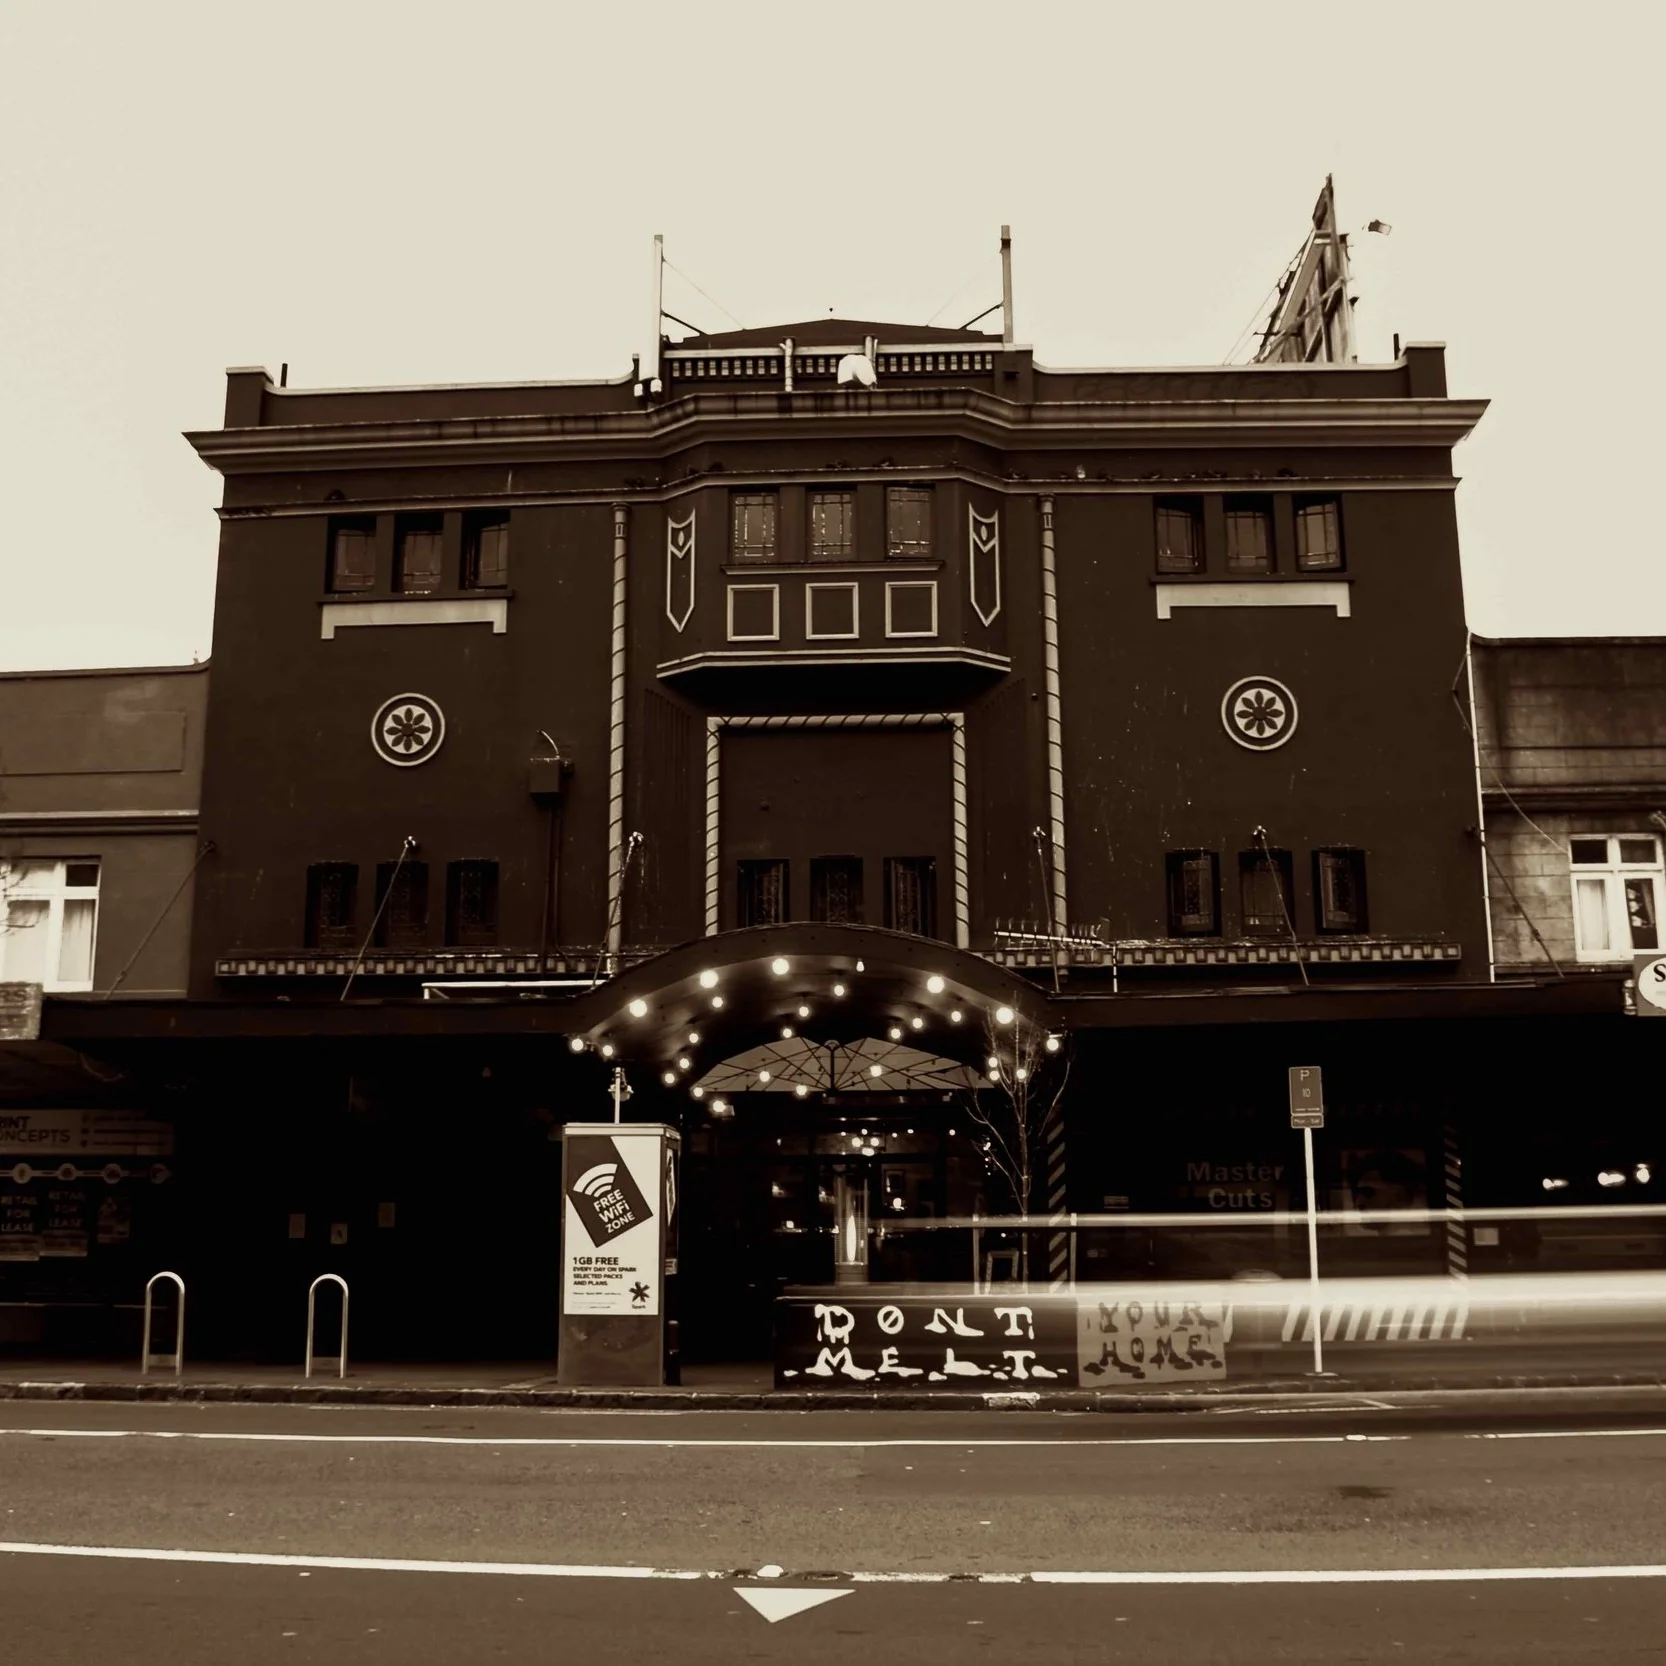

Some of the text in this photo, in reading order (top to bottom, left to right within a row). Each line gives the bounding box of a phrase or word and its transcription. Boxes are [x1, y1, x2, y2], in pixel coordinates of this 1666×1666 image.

[1300, 1069, 1310, 1081] P
[1302, 1088, 1312, 1098] 10
[1186, 1161, 1286, 1183] Master
[593, 1188, 624, 1213] FREE
[1208, 1187, 1273, 1209] Cuts
[598, 1199, 630, 1223] WiFi
[605, 1211, 636, 1234] ZONE
[595, 1257, 619, 1265] FREE
[1098, 1300, 1219, 1333] YOUR
[784, 1346, 1068, 1382] MELT
[1083, 1333, 1224, 1379] HOME
